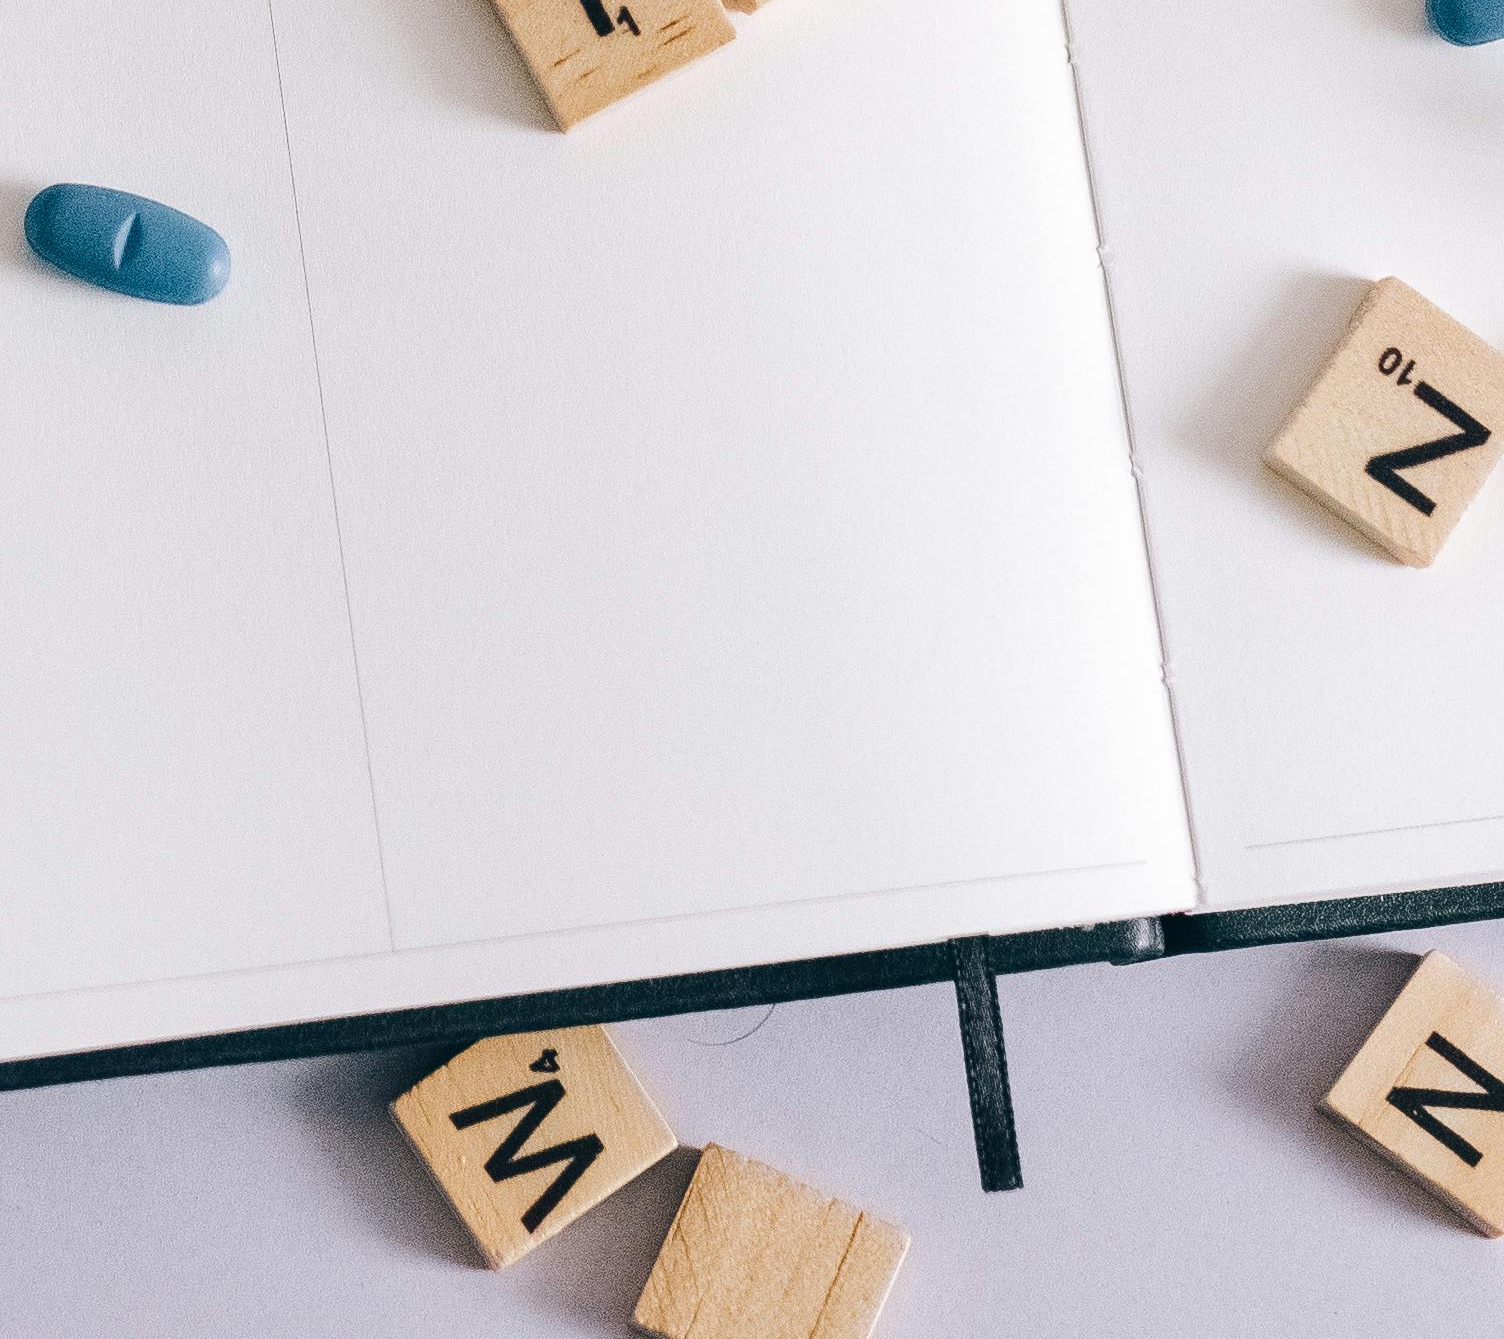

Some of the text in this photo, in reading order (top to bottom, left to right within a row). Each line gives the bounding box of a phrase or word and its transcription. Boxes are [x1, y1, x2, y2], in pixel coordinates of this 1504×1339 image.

[616, 6, 641, 36] 1
[1378, 347, 1416, 386] 10
[1364, 380, 1492, 517] Z
